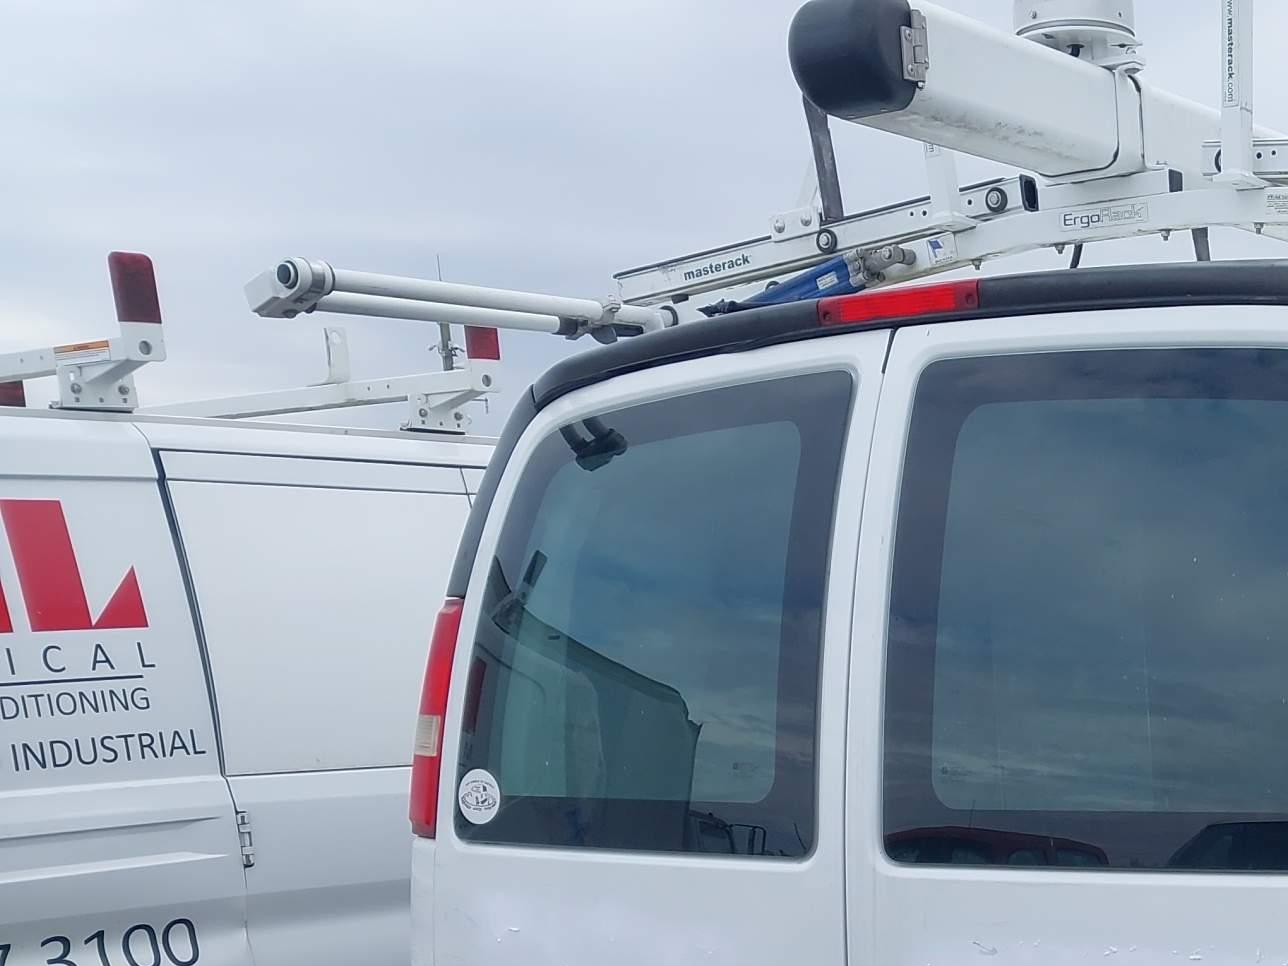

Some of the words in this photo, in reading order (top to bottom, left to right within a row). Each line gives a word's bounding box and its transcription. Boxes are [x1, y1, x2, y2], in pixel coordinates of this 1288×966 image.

[683, 253, 751, 281] masterack
[0, 687, 150, 720] DITIONING
[11, 729, 207, 772] INDUSTRIAL
